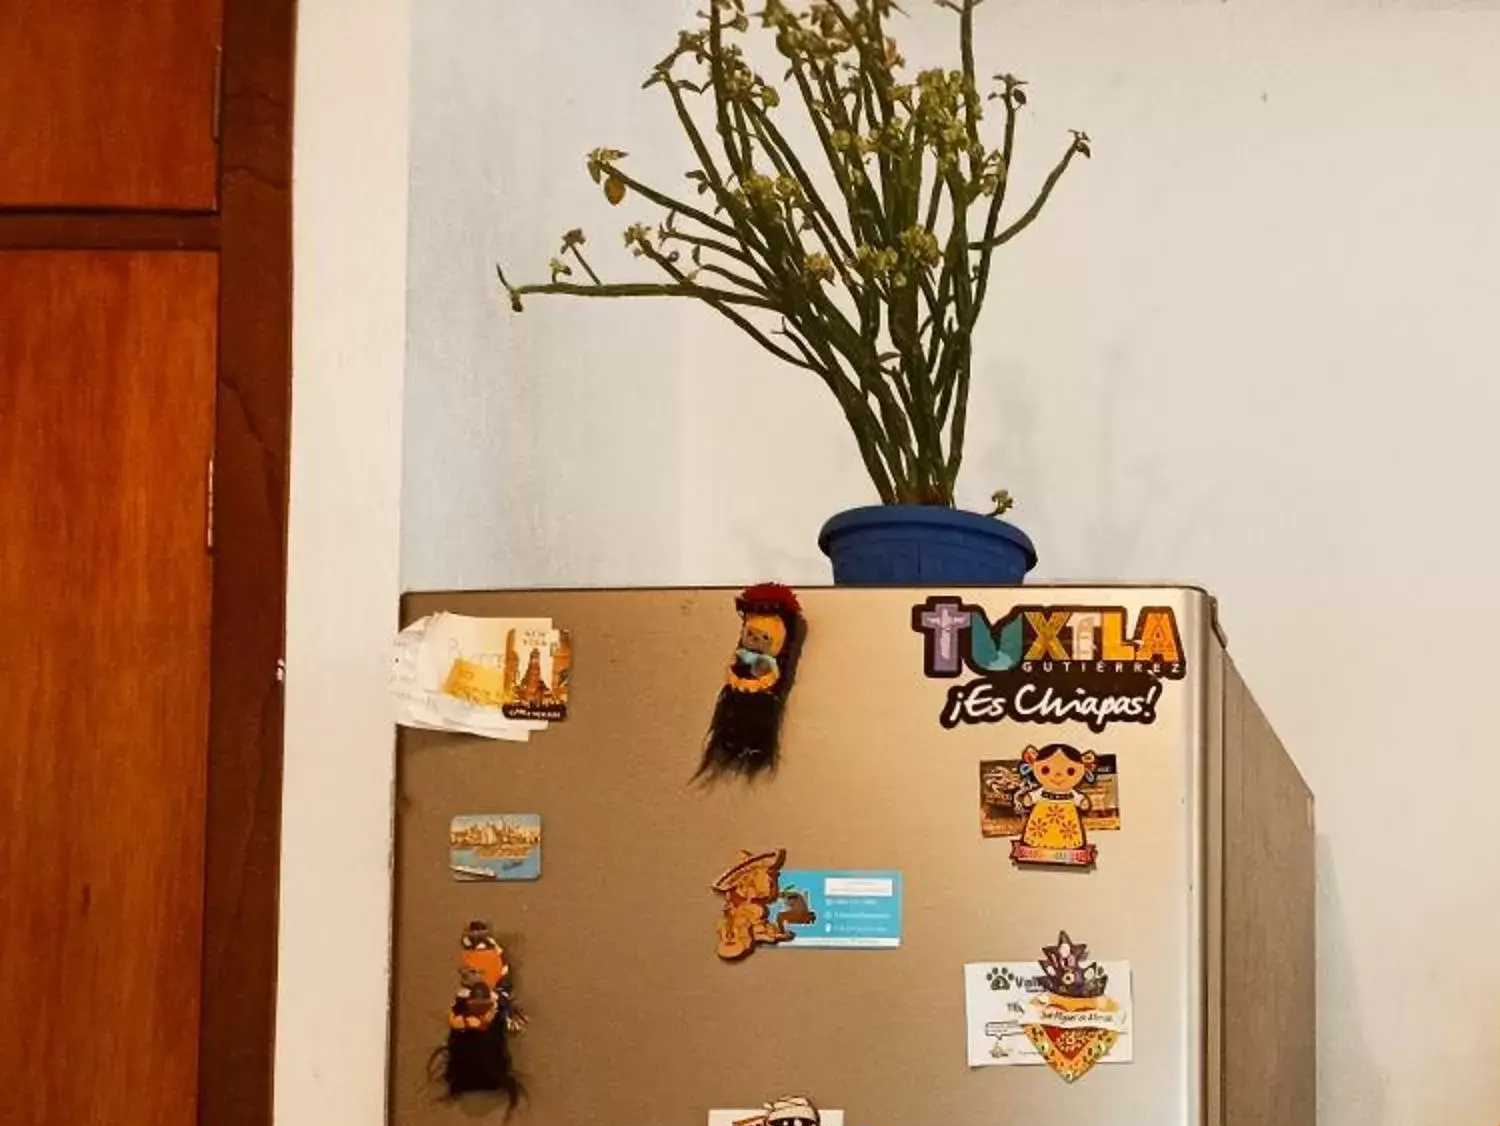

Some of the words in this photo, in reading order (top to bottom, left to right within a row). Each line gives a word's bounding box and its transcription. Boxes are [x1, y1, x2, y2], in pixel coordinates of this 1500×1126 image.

[921, 603, 1180, 672] TUXTLA
[950, 684, 1005, 721] ¡Es
[1015, 684, 1157, 724] Chiapas!
